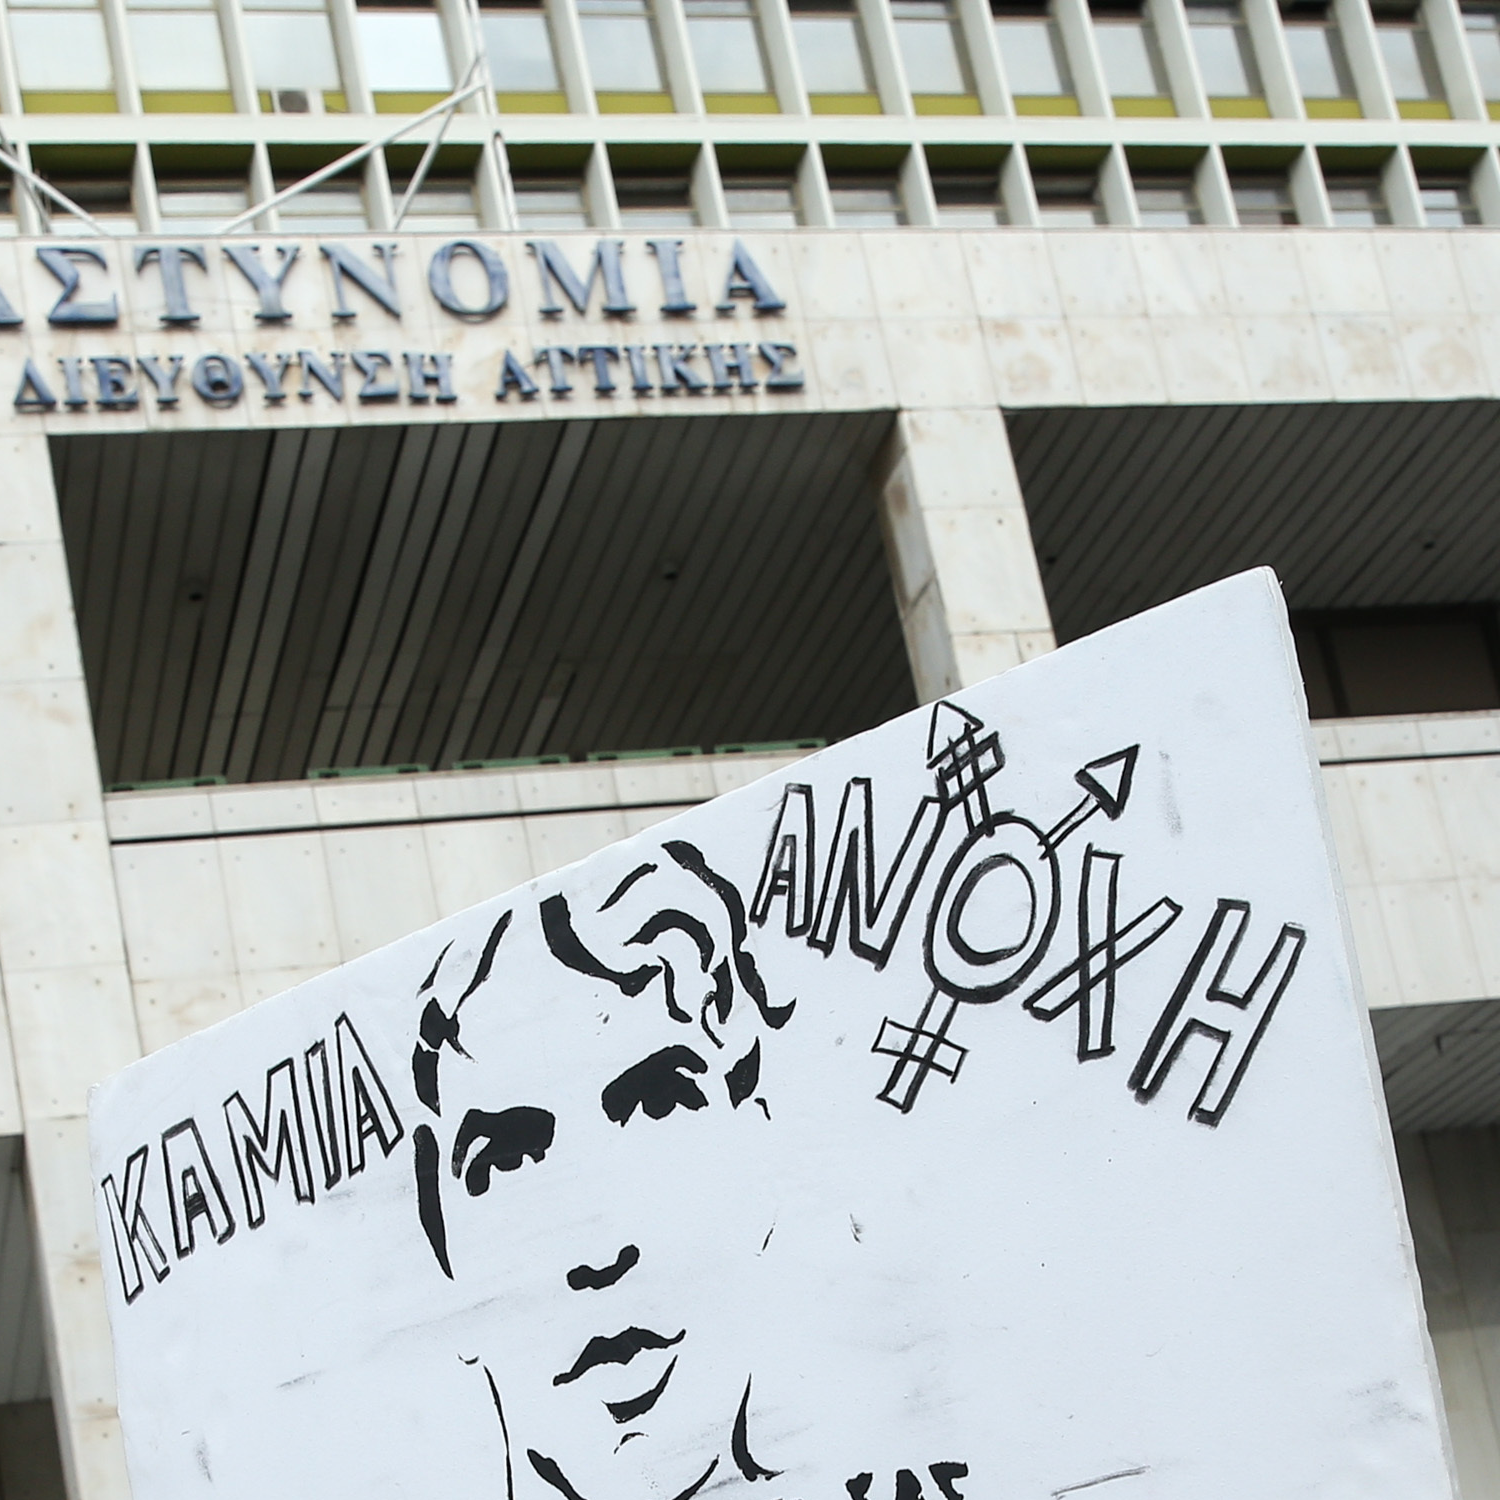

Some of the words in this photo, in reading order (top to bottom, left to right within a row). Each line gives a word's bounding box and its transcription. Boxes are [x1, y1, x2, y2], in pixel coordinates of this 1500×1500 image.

[12, 350, 459, 412] ΔΙΕΥΘΥΝΣΗ
[495, 343, 806, 399] ΑΤΤΙΚΗΣ
[100, 1011, 405, 1306] ΚΑΜΙΑ
[748, 776, 1307, 1128] ΑΝΟΧΗ
